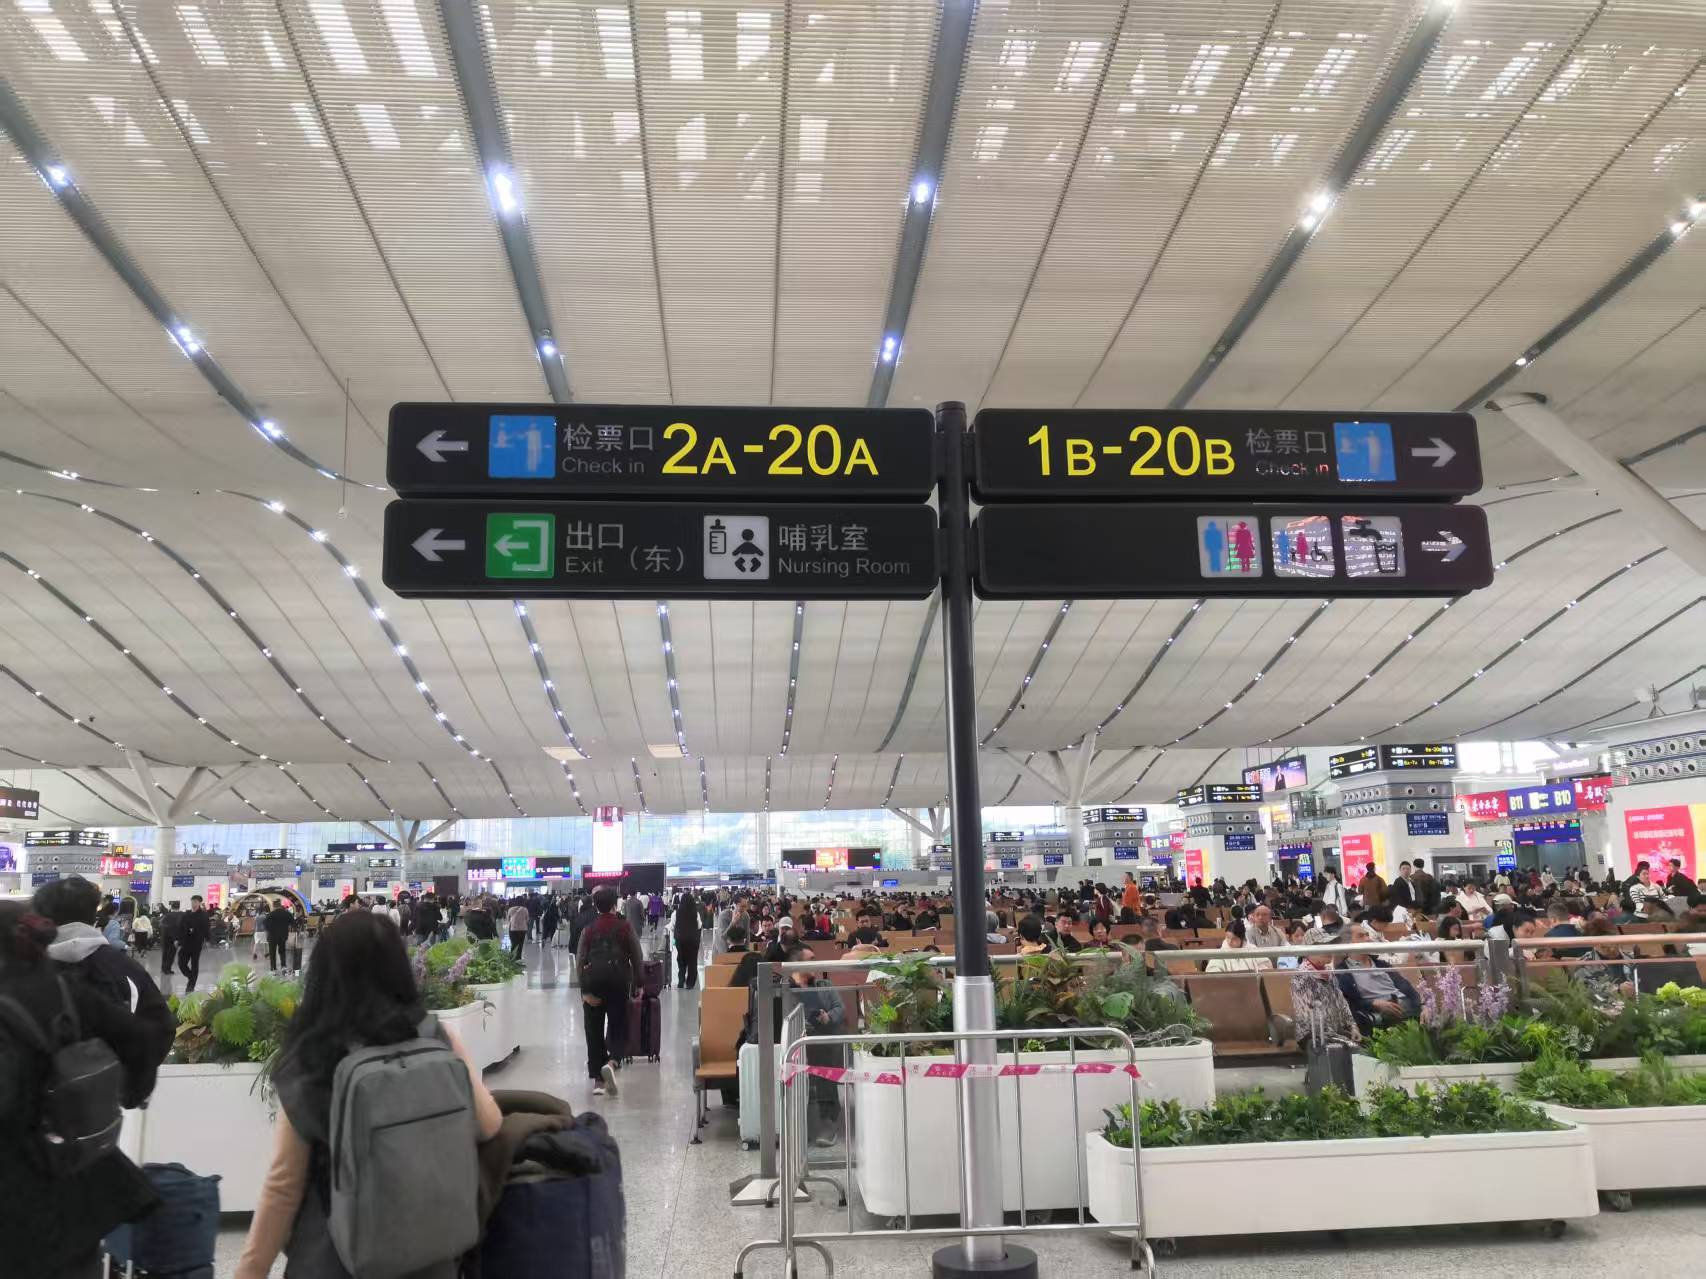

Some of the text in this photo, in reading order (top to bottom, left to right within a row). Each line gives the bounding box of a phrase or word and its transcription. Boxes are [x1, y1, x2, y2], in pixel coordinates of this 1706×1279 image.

[563, 422, 653, 451] 检票口
[661, 423, 879, 476] 2A-20A
[1028, 424, 1236, 477] 1B-20B
[1245, 427, 1327, 456] 检票口
[561, 457, 644, 473] Check in
[566, 520, 623, 550] 出口
[778, 523, 868, 551] 哺乳室
[565, 556, 604, 573] Exit
[778, 557, 910, 578] Nursing Room
